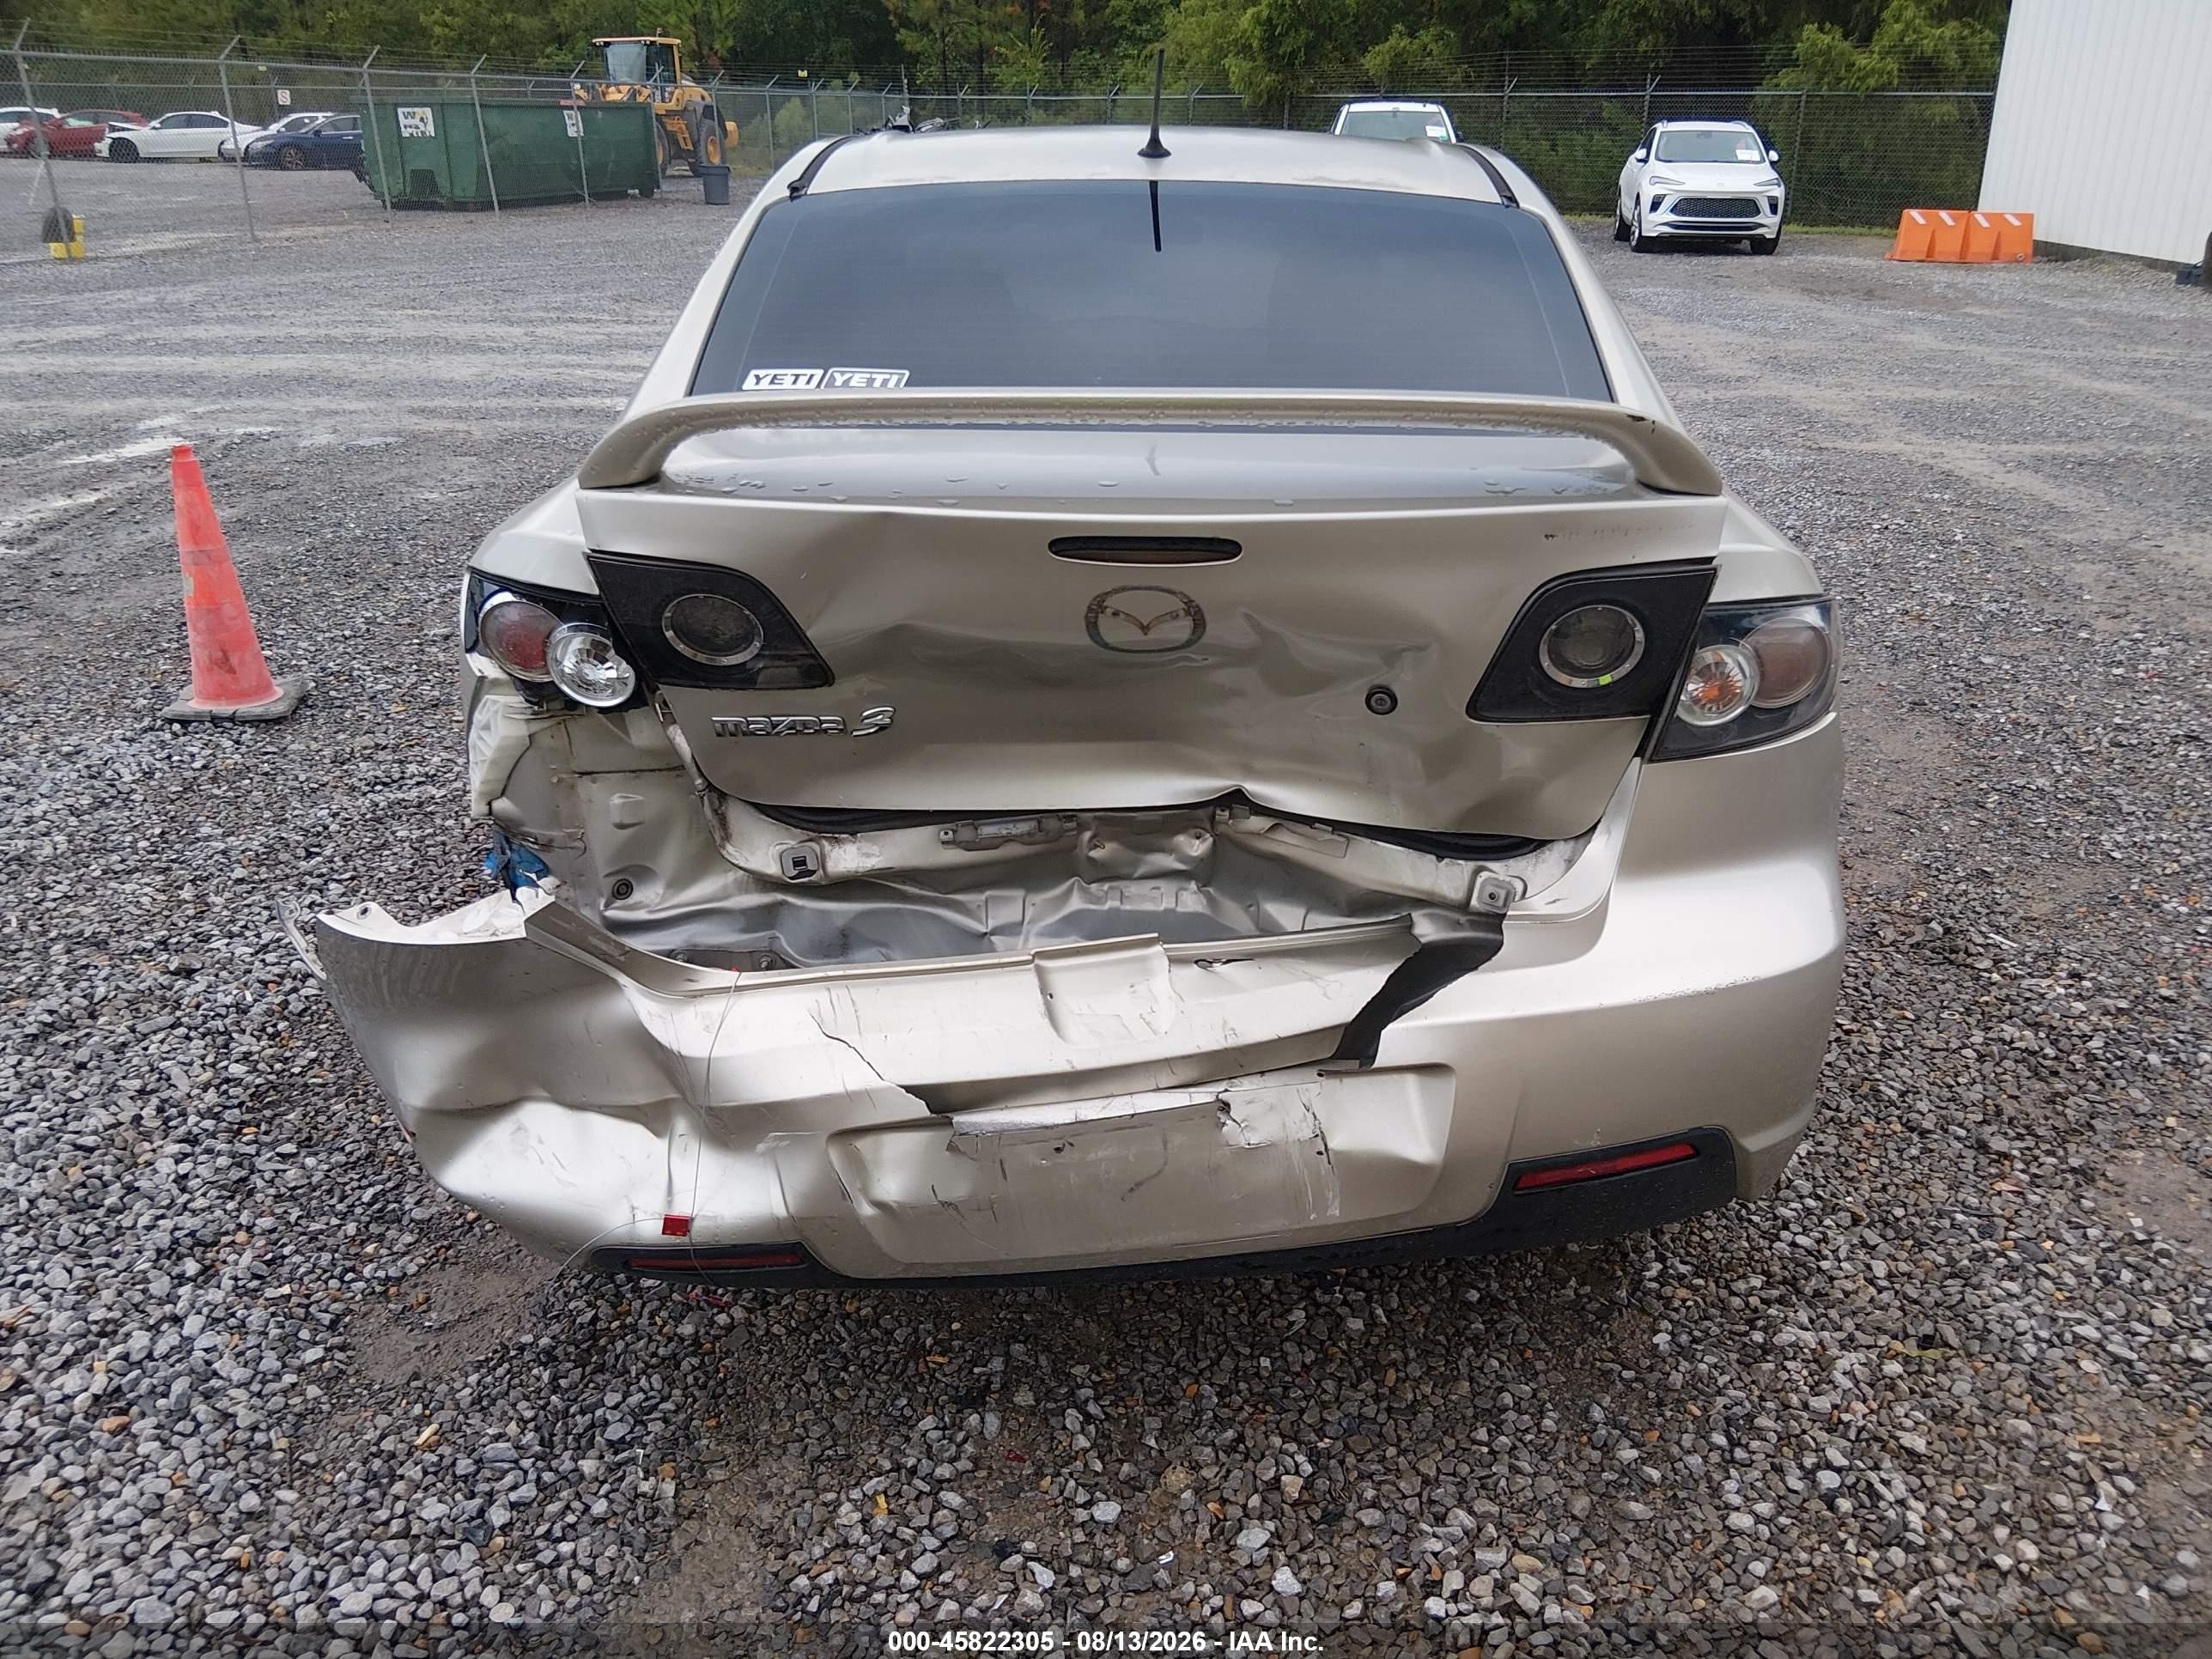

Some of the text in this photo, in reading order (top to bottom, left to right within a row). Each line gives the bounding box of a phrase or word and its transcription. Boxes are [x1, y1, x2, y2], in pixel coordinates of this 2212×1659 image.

[753, 374, 817, 386] YETI
[833, 372, 900, 388] YETI
[851, 707, 896, 737] 3
